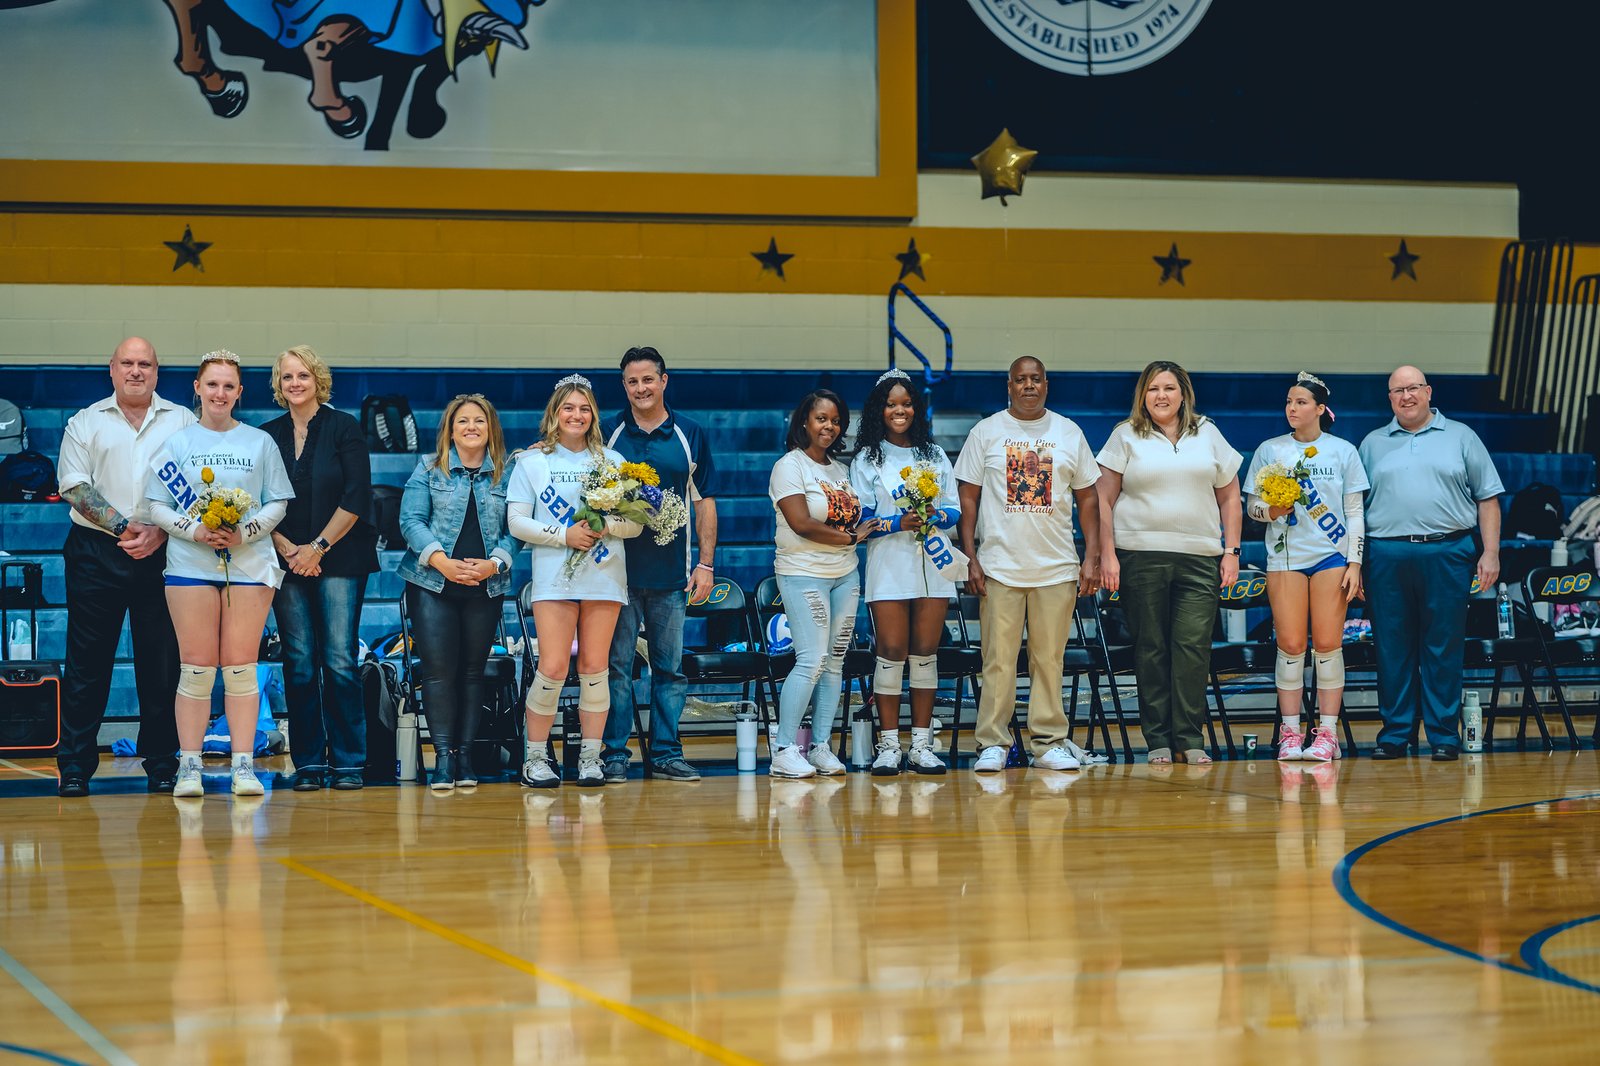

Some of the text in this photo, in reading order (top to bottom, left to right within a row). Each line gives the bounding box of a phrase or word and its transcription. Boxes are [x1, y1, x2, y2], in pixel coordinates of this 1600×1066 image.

[1145, 3, 1181, 38] 1974
[1002, 438, 1057, 449] Long Live
[191, 458, 254, 467] VOLLEYBALL
[1312, 467, 1335, 476] BALL
[1004, 503, 1054, 517] First Lady
[1309, 503, 1329, 520] 2025
[1541, 572, 1592, 595] ACC
